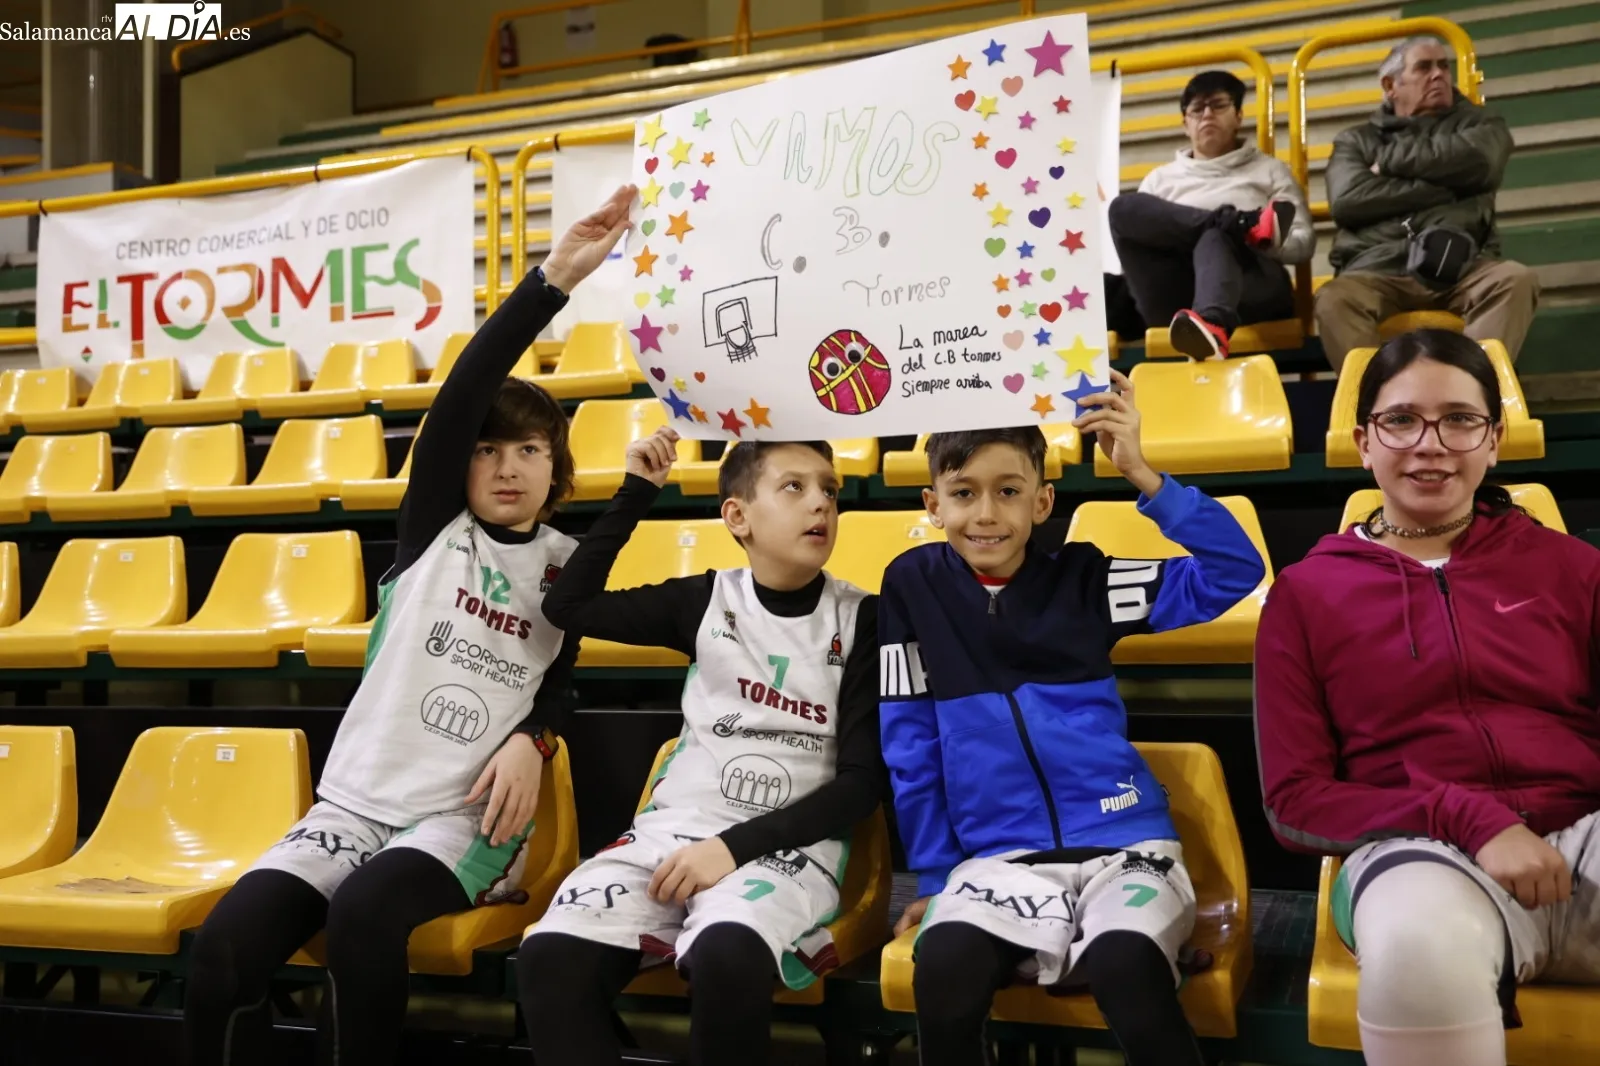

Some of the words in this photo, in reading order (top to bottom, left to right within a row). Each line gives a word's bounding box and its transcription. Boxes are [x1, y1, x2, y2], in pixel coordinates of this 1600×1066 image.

[731, 106, 960, 198] VAMOS
[116, 237, 192, 261] CENTRO
[196, 221, 296, 255] COMERCIAL
[301, 219, 313, 239] Y
[316, 216, 340, 237] DE
[345, 206, 390, 232] OCIO
[62, 278, 120, 333] EL
[117, 237, 443, 359] TORMES
[842, 274, 951, 307] Tormes
[898, 324, 924, 351] La
[933, 325, 988, 346] marea
[901, 353, 926, 375] del
[480, 565, 511, 605] 12
[455, 587, 532, 640] TORMES
[450, 653, 485, 675] SPORT
[484, 668, 525, 692] HEALTH
[455, 638, 529, 680] CORPORE
[767, 654, 790, 690] 7
[737, 677, 828, 725] TORMES
[741, 729, 779, 743] SPORT
[780, 735, 823, 754] HEALTH
[1100, 789, 1139, 814] PUMA
[1122, 883, 1159, 908] 7
